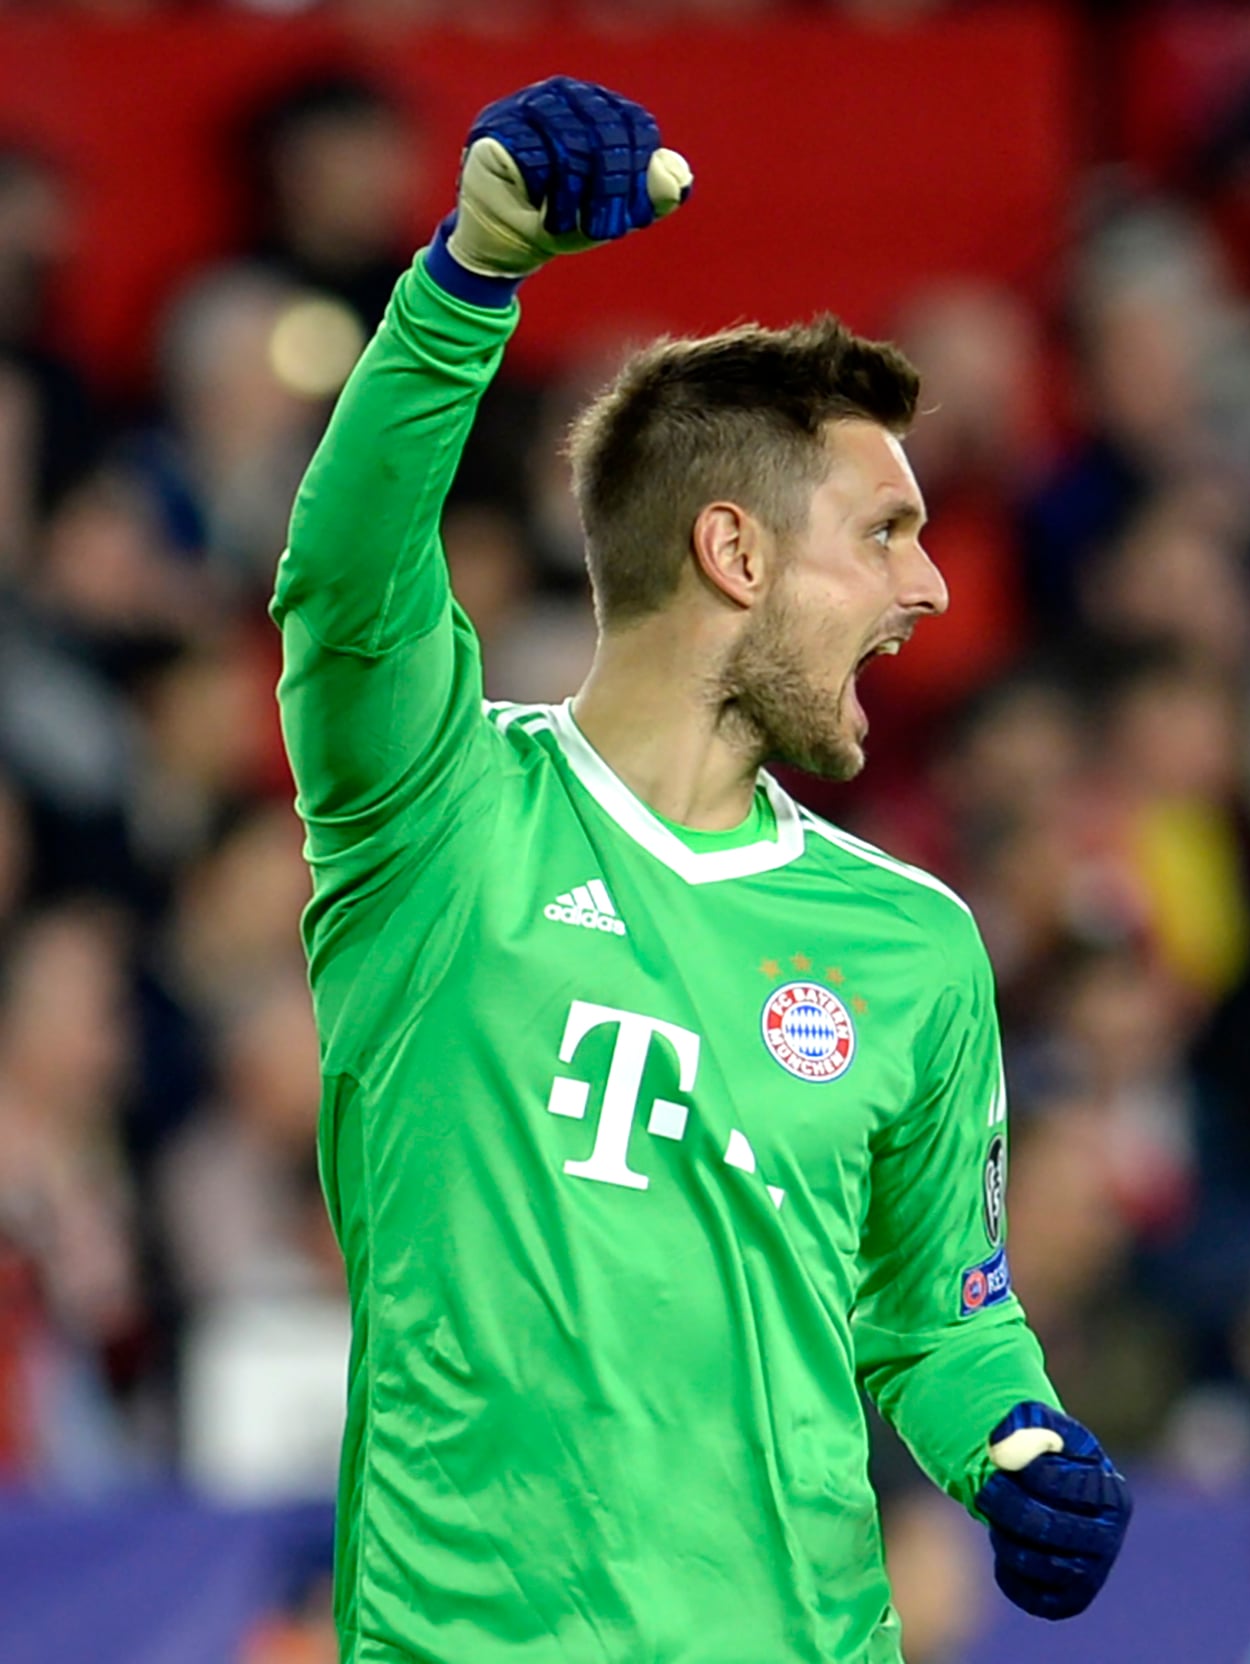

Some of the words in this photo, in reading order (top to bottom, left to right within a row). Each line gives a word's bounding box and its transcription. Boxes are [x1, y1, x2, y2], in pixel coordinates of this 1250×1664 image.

[543, 903, 626, 936] adidas
[770, 990, 794, 1015] FC
[794, 987, 849, 1039] BAYERN
[557, 999, 701, 1191] T
